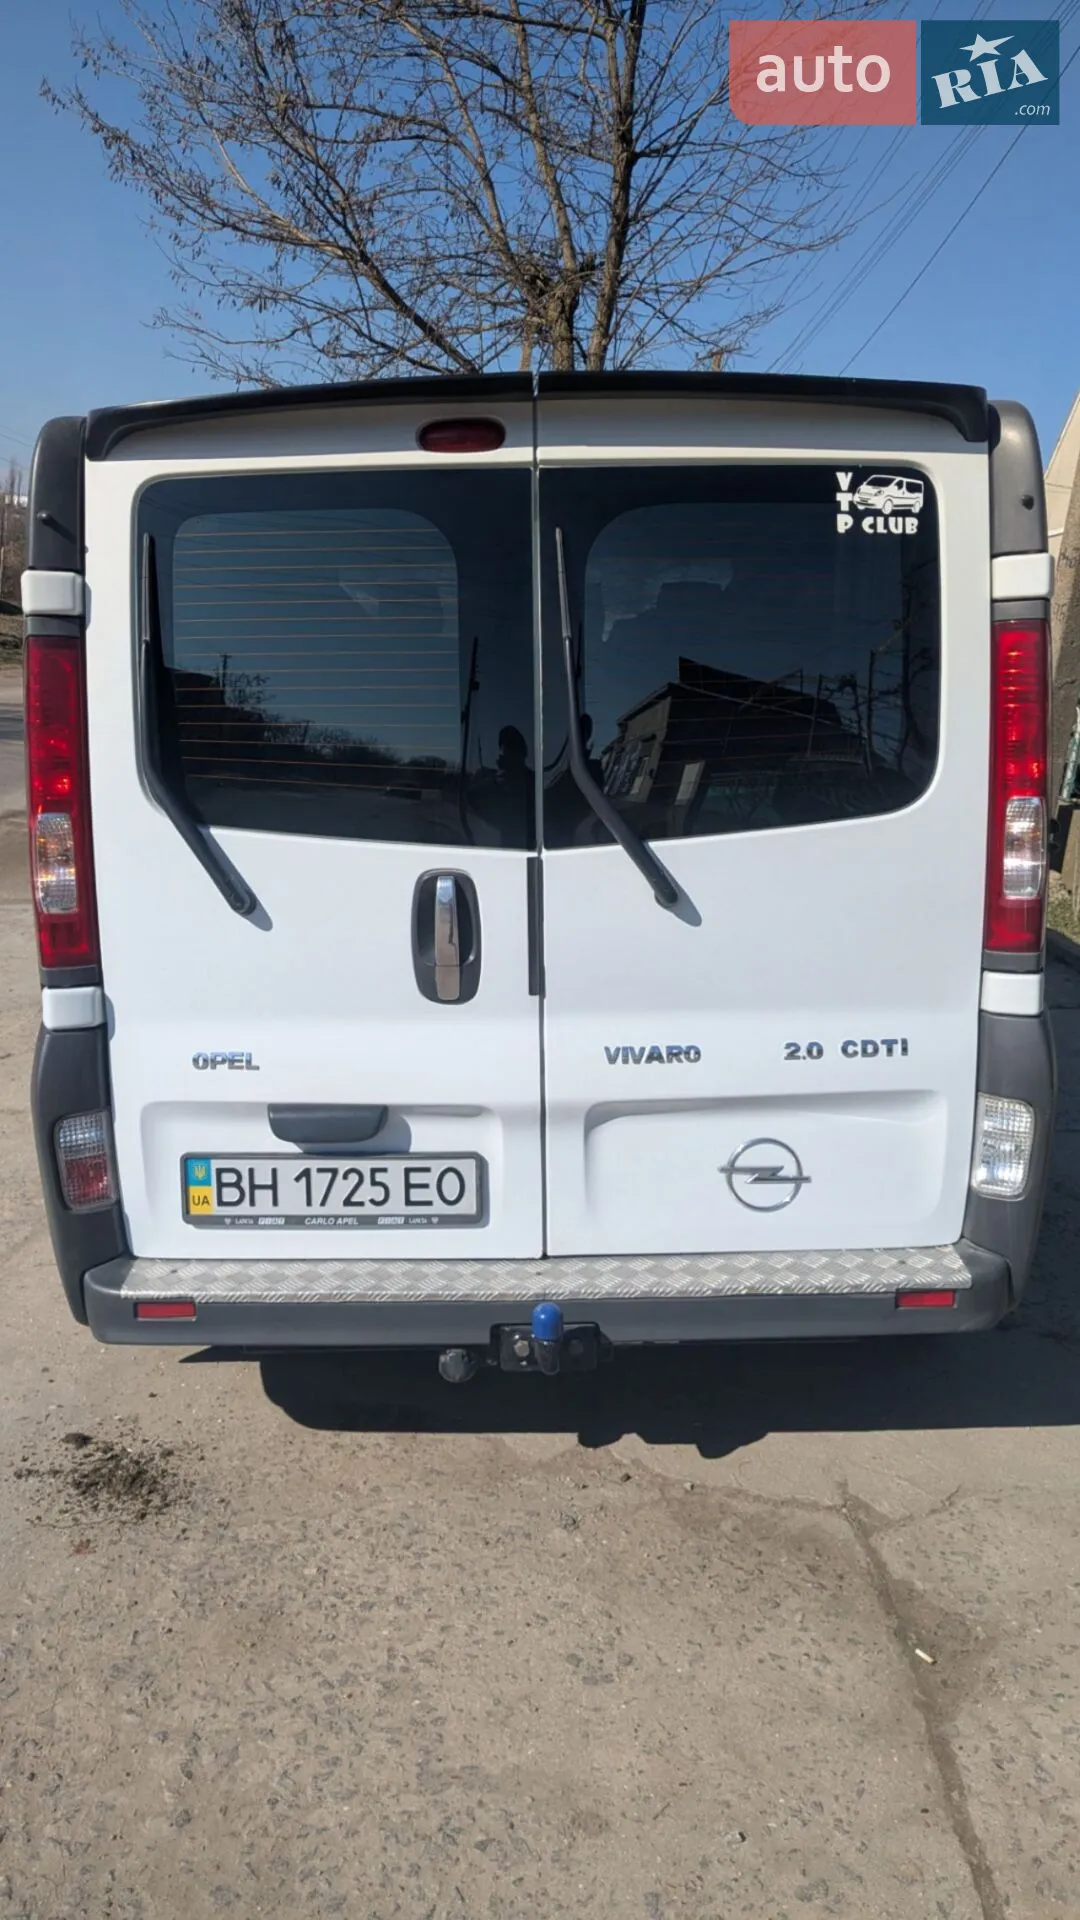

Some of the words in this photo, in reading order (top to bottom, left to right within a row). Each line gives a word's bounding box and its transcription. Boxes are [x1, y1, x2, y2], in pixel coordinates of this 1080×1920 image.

[861, 516, 919, 534] CLUB
[603, 1045, 702, 1065] VIVARO
[783, 1041, 824, 1061] 2.0
[840, 1038, 909, 1058] CDTI
[191, 1052, 260, 1071] OPEL
[215, 1167, 279, 1207] BH
[293, 1167, 391, 1207] 1725
[403, 1166, 466, 1207] EO
[191, 1195, 210, 1207] UA
[304, 1216, 335, 1225] CARLO
[335, 1216, 359, 1225] APEL
